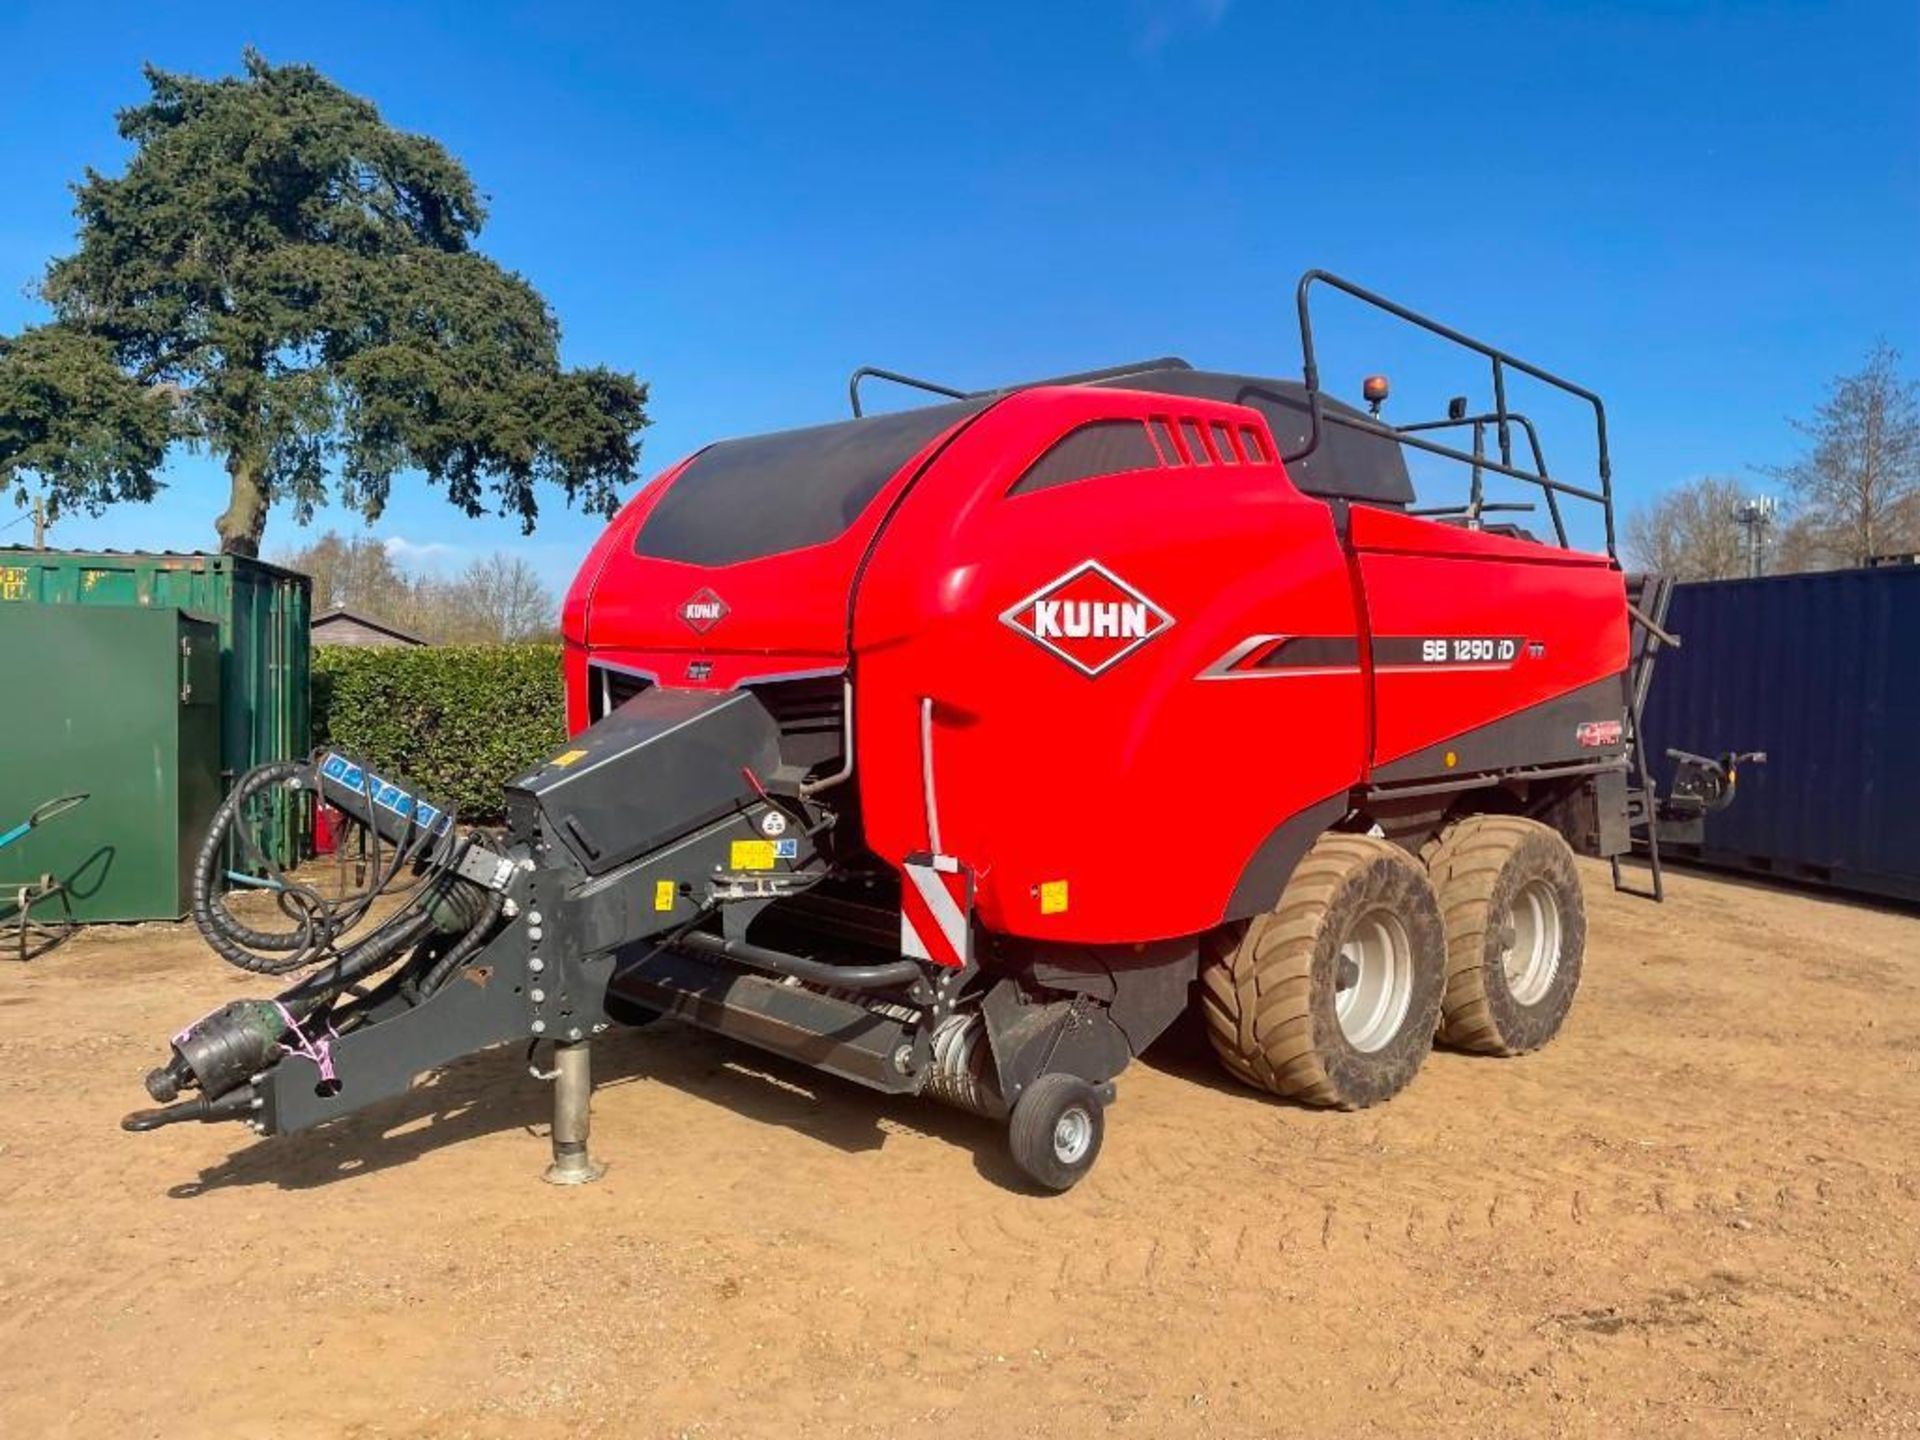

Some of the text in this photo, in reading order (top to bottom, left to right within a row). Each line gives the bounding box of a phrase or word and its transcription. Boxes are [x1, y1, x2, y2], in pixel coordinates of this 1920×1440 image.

[686, 602, 721, 619] KUHN
[1034, 600, 1147, 638] KUHN
[1422, 639, 1448, 662] SB
[1453, 639, 1494, 661] 1290
